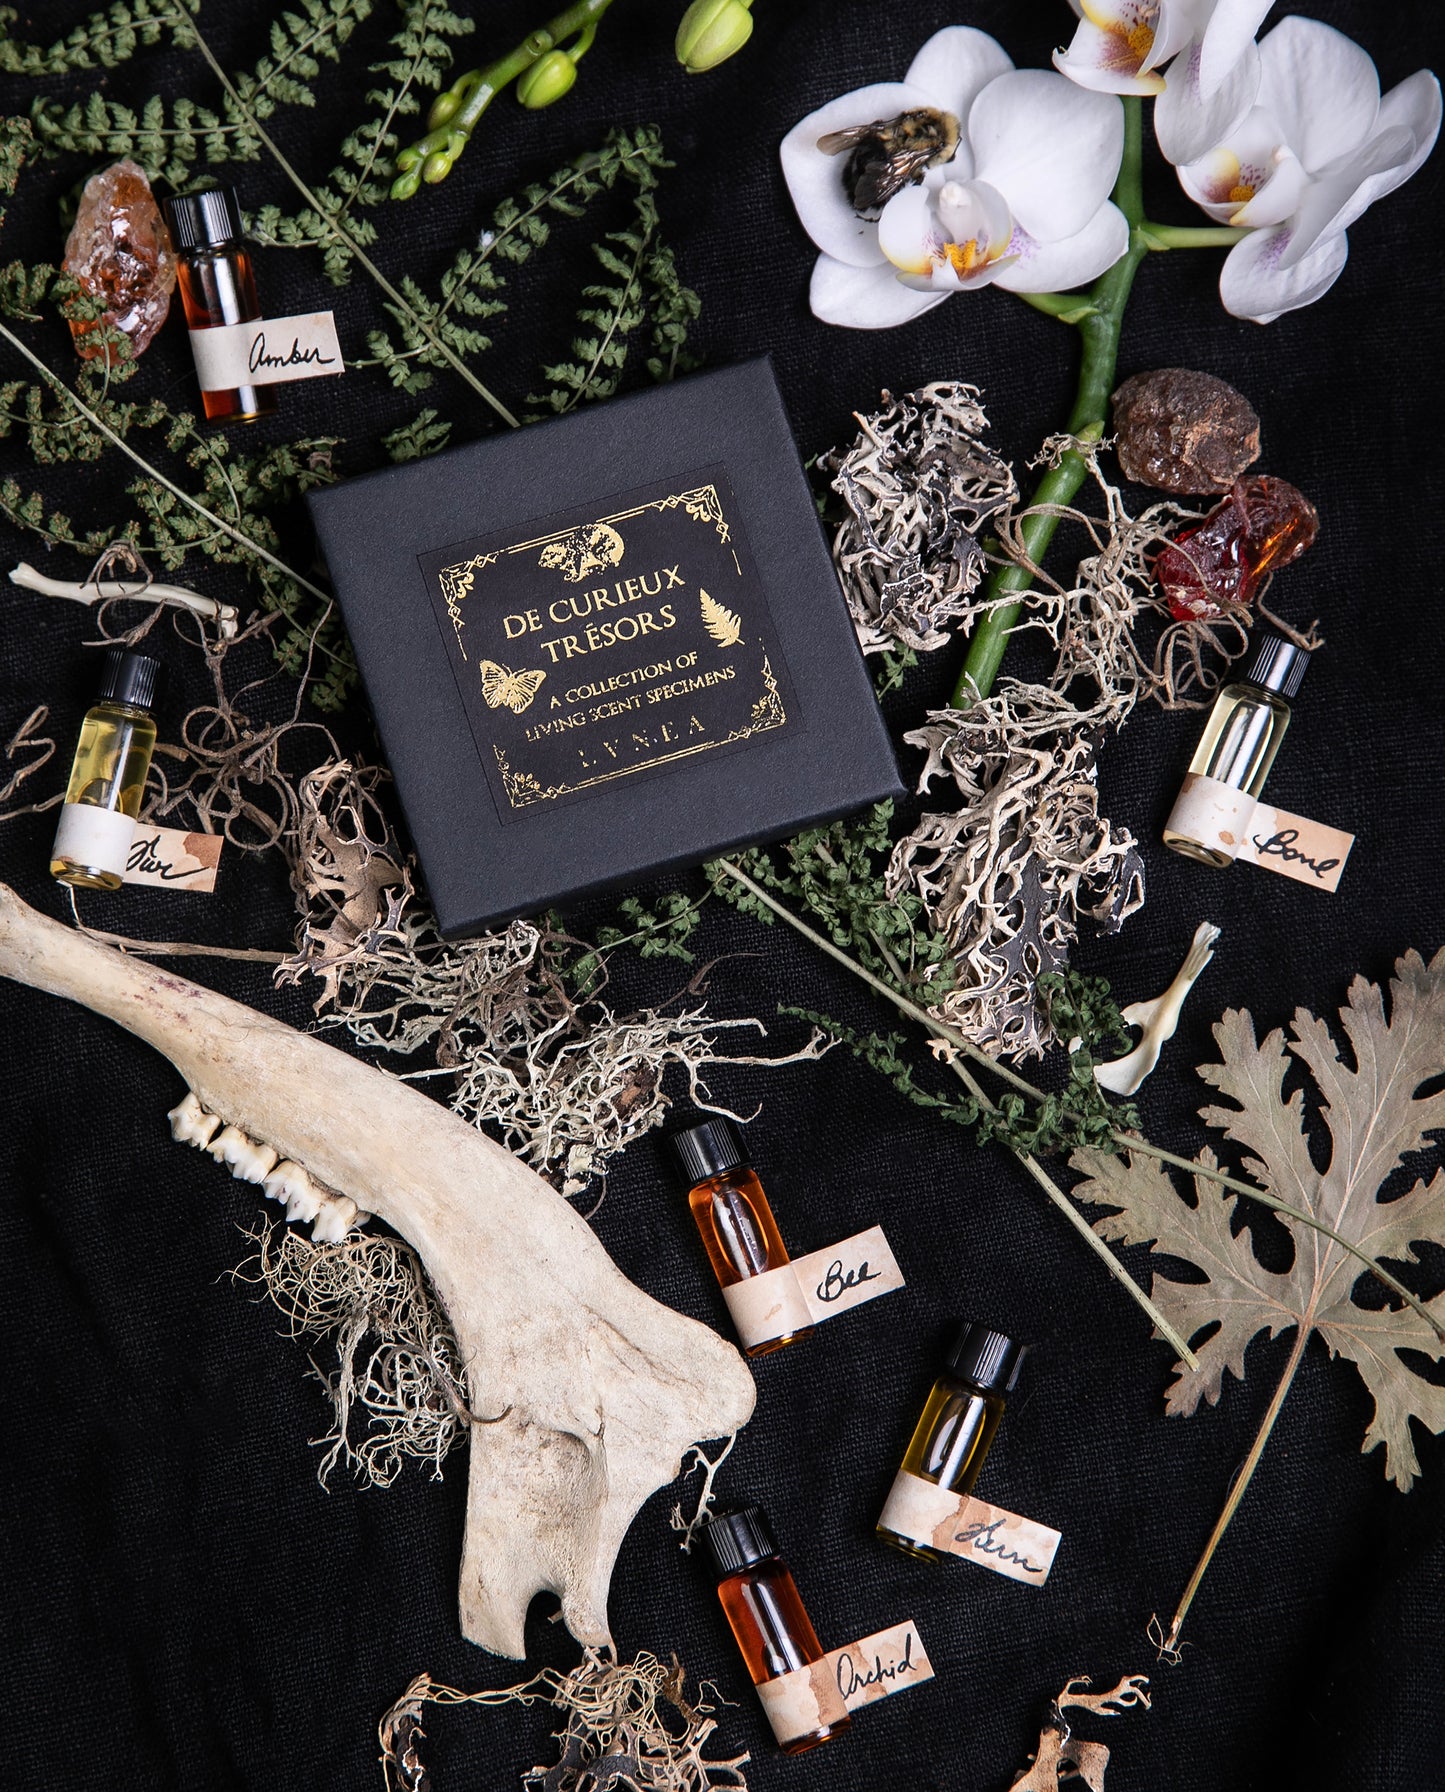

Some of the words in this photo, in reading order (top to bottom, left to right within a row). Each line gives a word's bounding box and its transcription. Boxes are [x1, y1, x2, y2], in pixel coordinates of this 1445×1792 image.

[249, 331, 335, 373] Amber
[503, 608, 543, 639] DE
[548, 564, 686, 624] CURIEUX
[540, 604, 677, 663] TRÉSORS
[525, 711, 586, 742] LIVING
[588, 694, 642, 722] SCENT
[645, 665, 736, 704] SPECIMENS
[550, 695, 562, 709] A
[565, 659, 673, 704] COLLECTION
[675, 651, 698, 669] OF
[1252, 829, 1340, 878] Bone
[816, 1259, 882, 1302] Bee
[837, 1633, 917, 1700] Orchid
